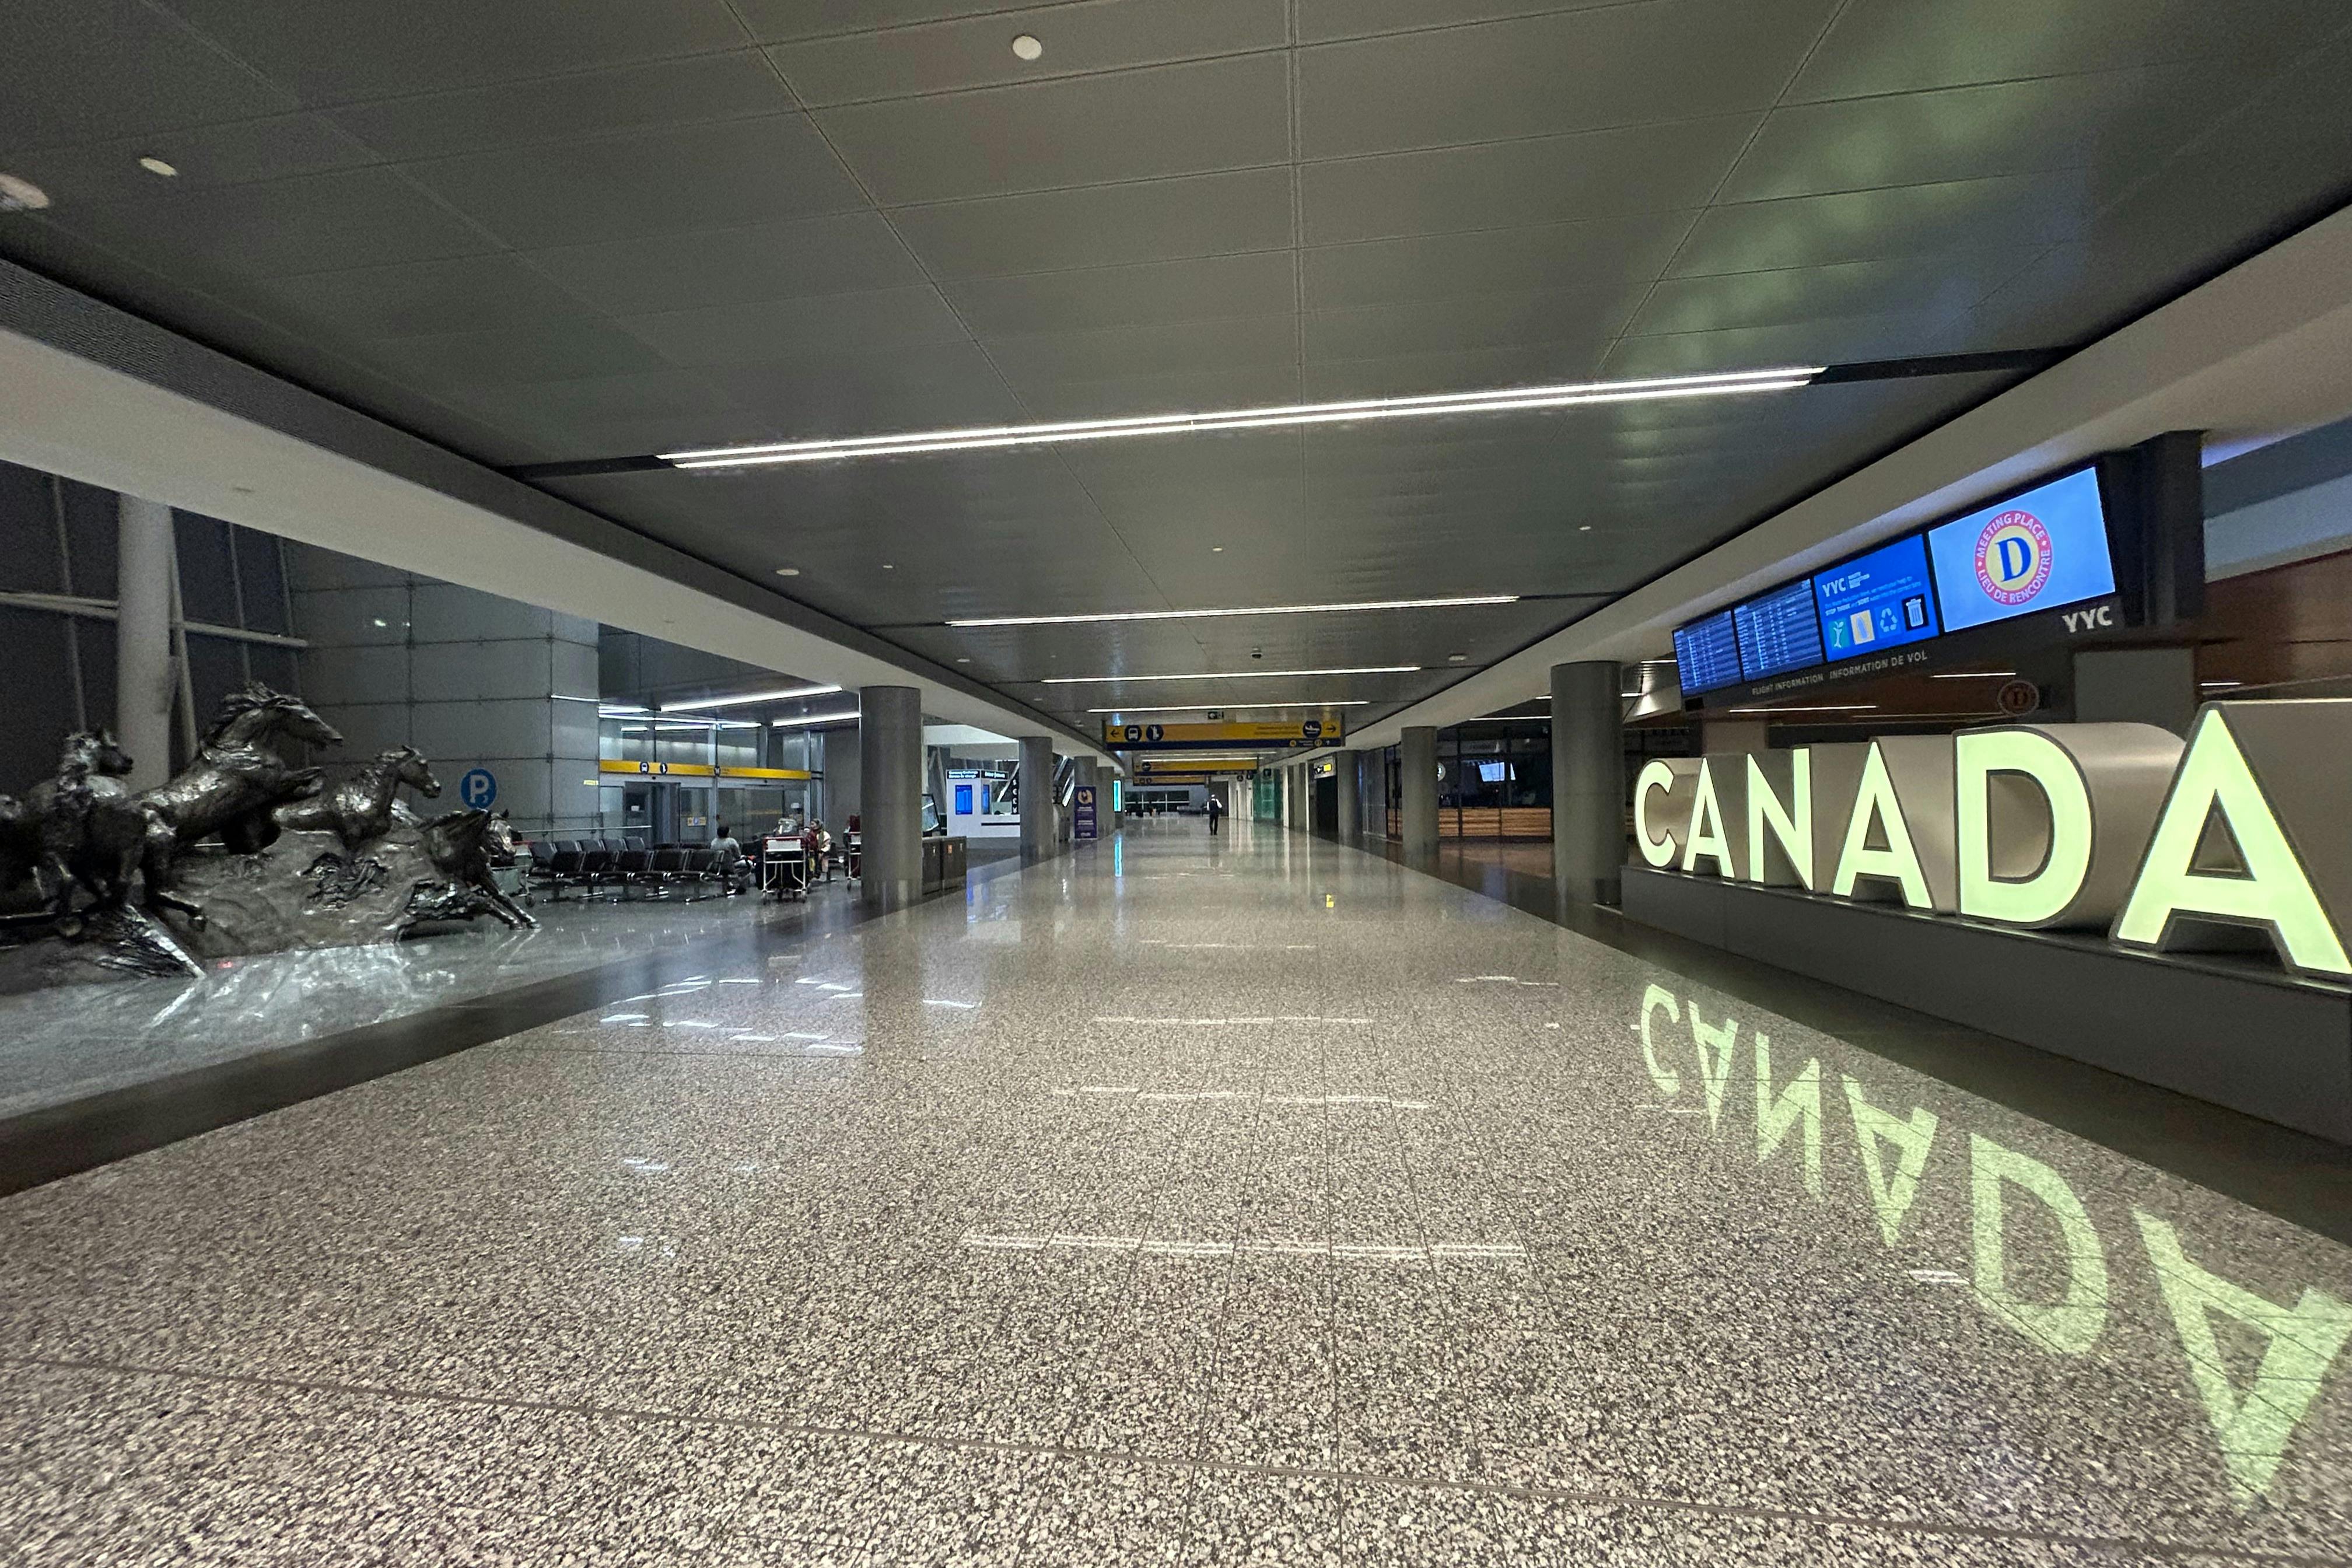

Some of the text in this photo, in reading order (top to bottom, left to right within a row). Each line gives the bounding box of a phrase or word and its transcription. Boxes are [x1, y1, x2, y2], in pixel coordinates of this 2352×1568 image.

[1977, 513, 2046, 558] MEETING PLACE
[1978, 550, 2050, 603] LIEU DE RENCONTRE
[1995, 537, 2031, 582] D
[1822, 578, 1846, 597] YYC
[2062, 606, 2113, 633] YYC
[1829, 650, 1928, 680] INFORMATION DE VOL
[1752, 673, 1824, 695] FLIGHT INFORMATION
[1635, 708, 2352, 975] CANADA
